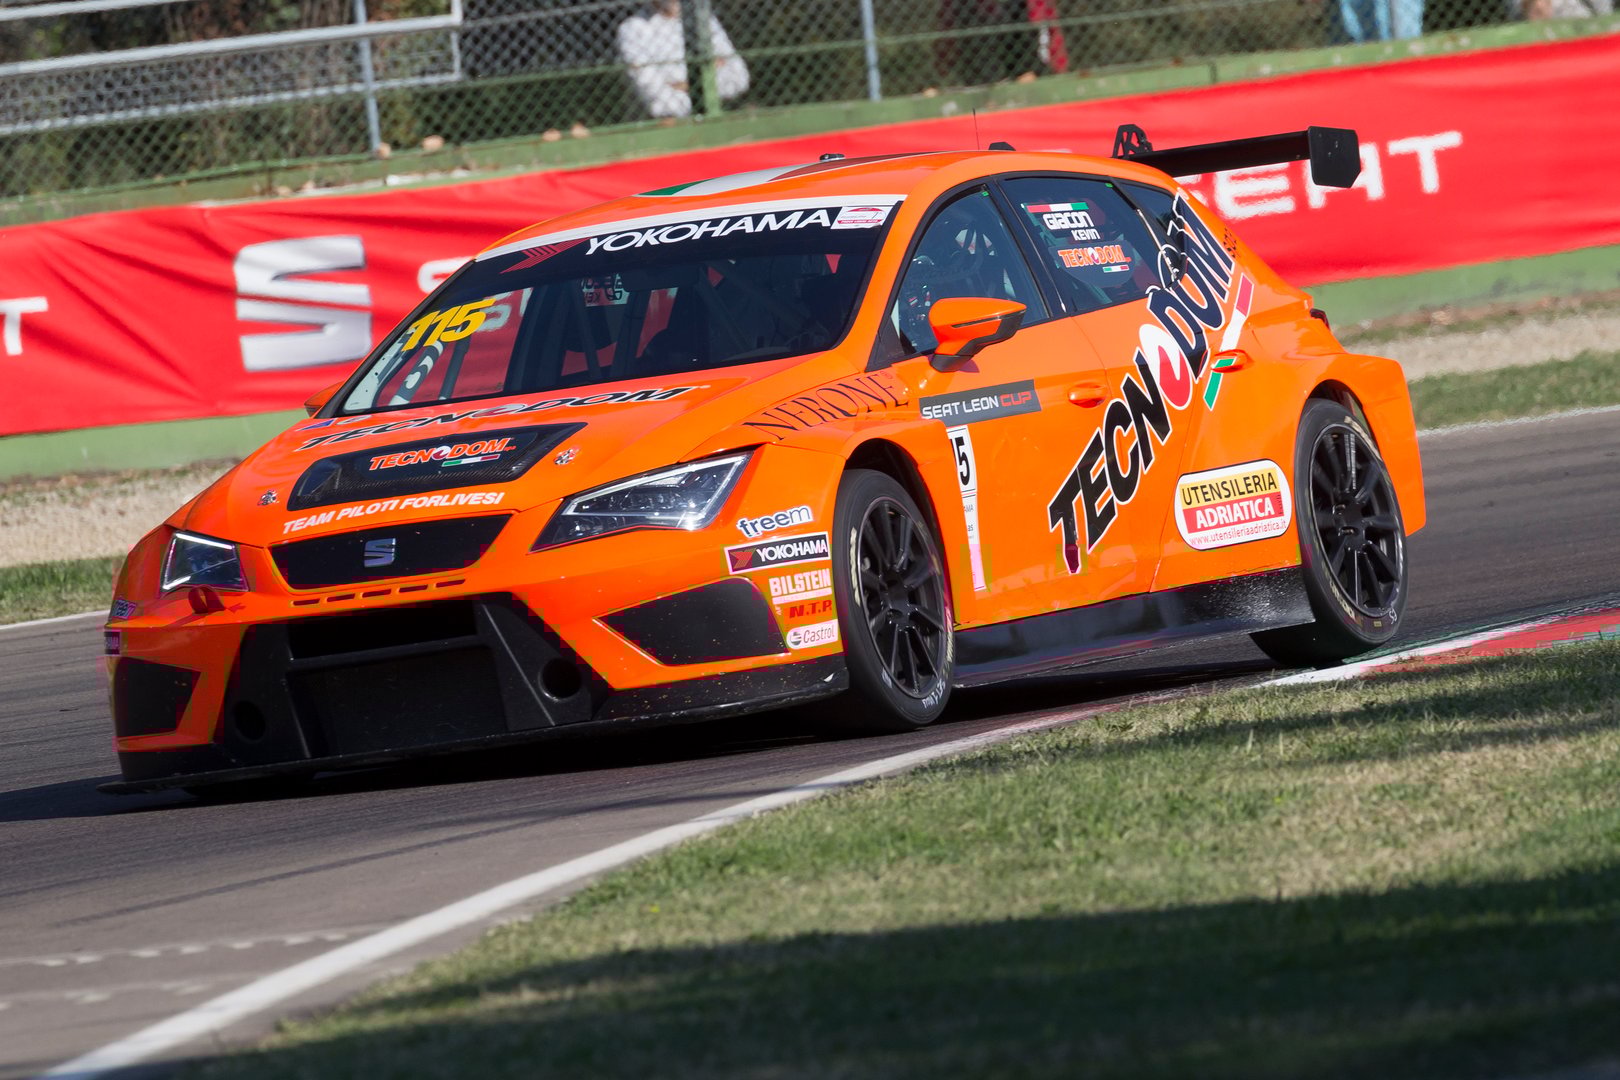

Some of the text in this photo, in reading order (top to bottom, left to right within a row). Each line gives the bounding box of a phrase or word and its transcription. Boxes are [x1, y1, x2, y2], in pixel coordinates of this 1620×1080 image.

[585, 209, 831, 256] YOKOHAMA
[401, 298, 496, 352] 115
[741, 373, 910, 441] NERONE
[921, 391, 1032, 420] SEAT LEON CUP
[1181, 472, 1278, 506] UTENSILERIA
[282, 492, 505, 534] TEAM PILOTI FORLIVESI
[738, 506, 811, 537] freem
[1195, 497, 1275, 529] ADRIATICA
[1189, 519, 1287, 545] www.utensileriaadriatica.it
[756, 539, 828, 562] YOKOHAMA
[769, 568, 831, 596] BILSTEIN
[803, 627, 835, 644] Castrol
